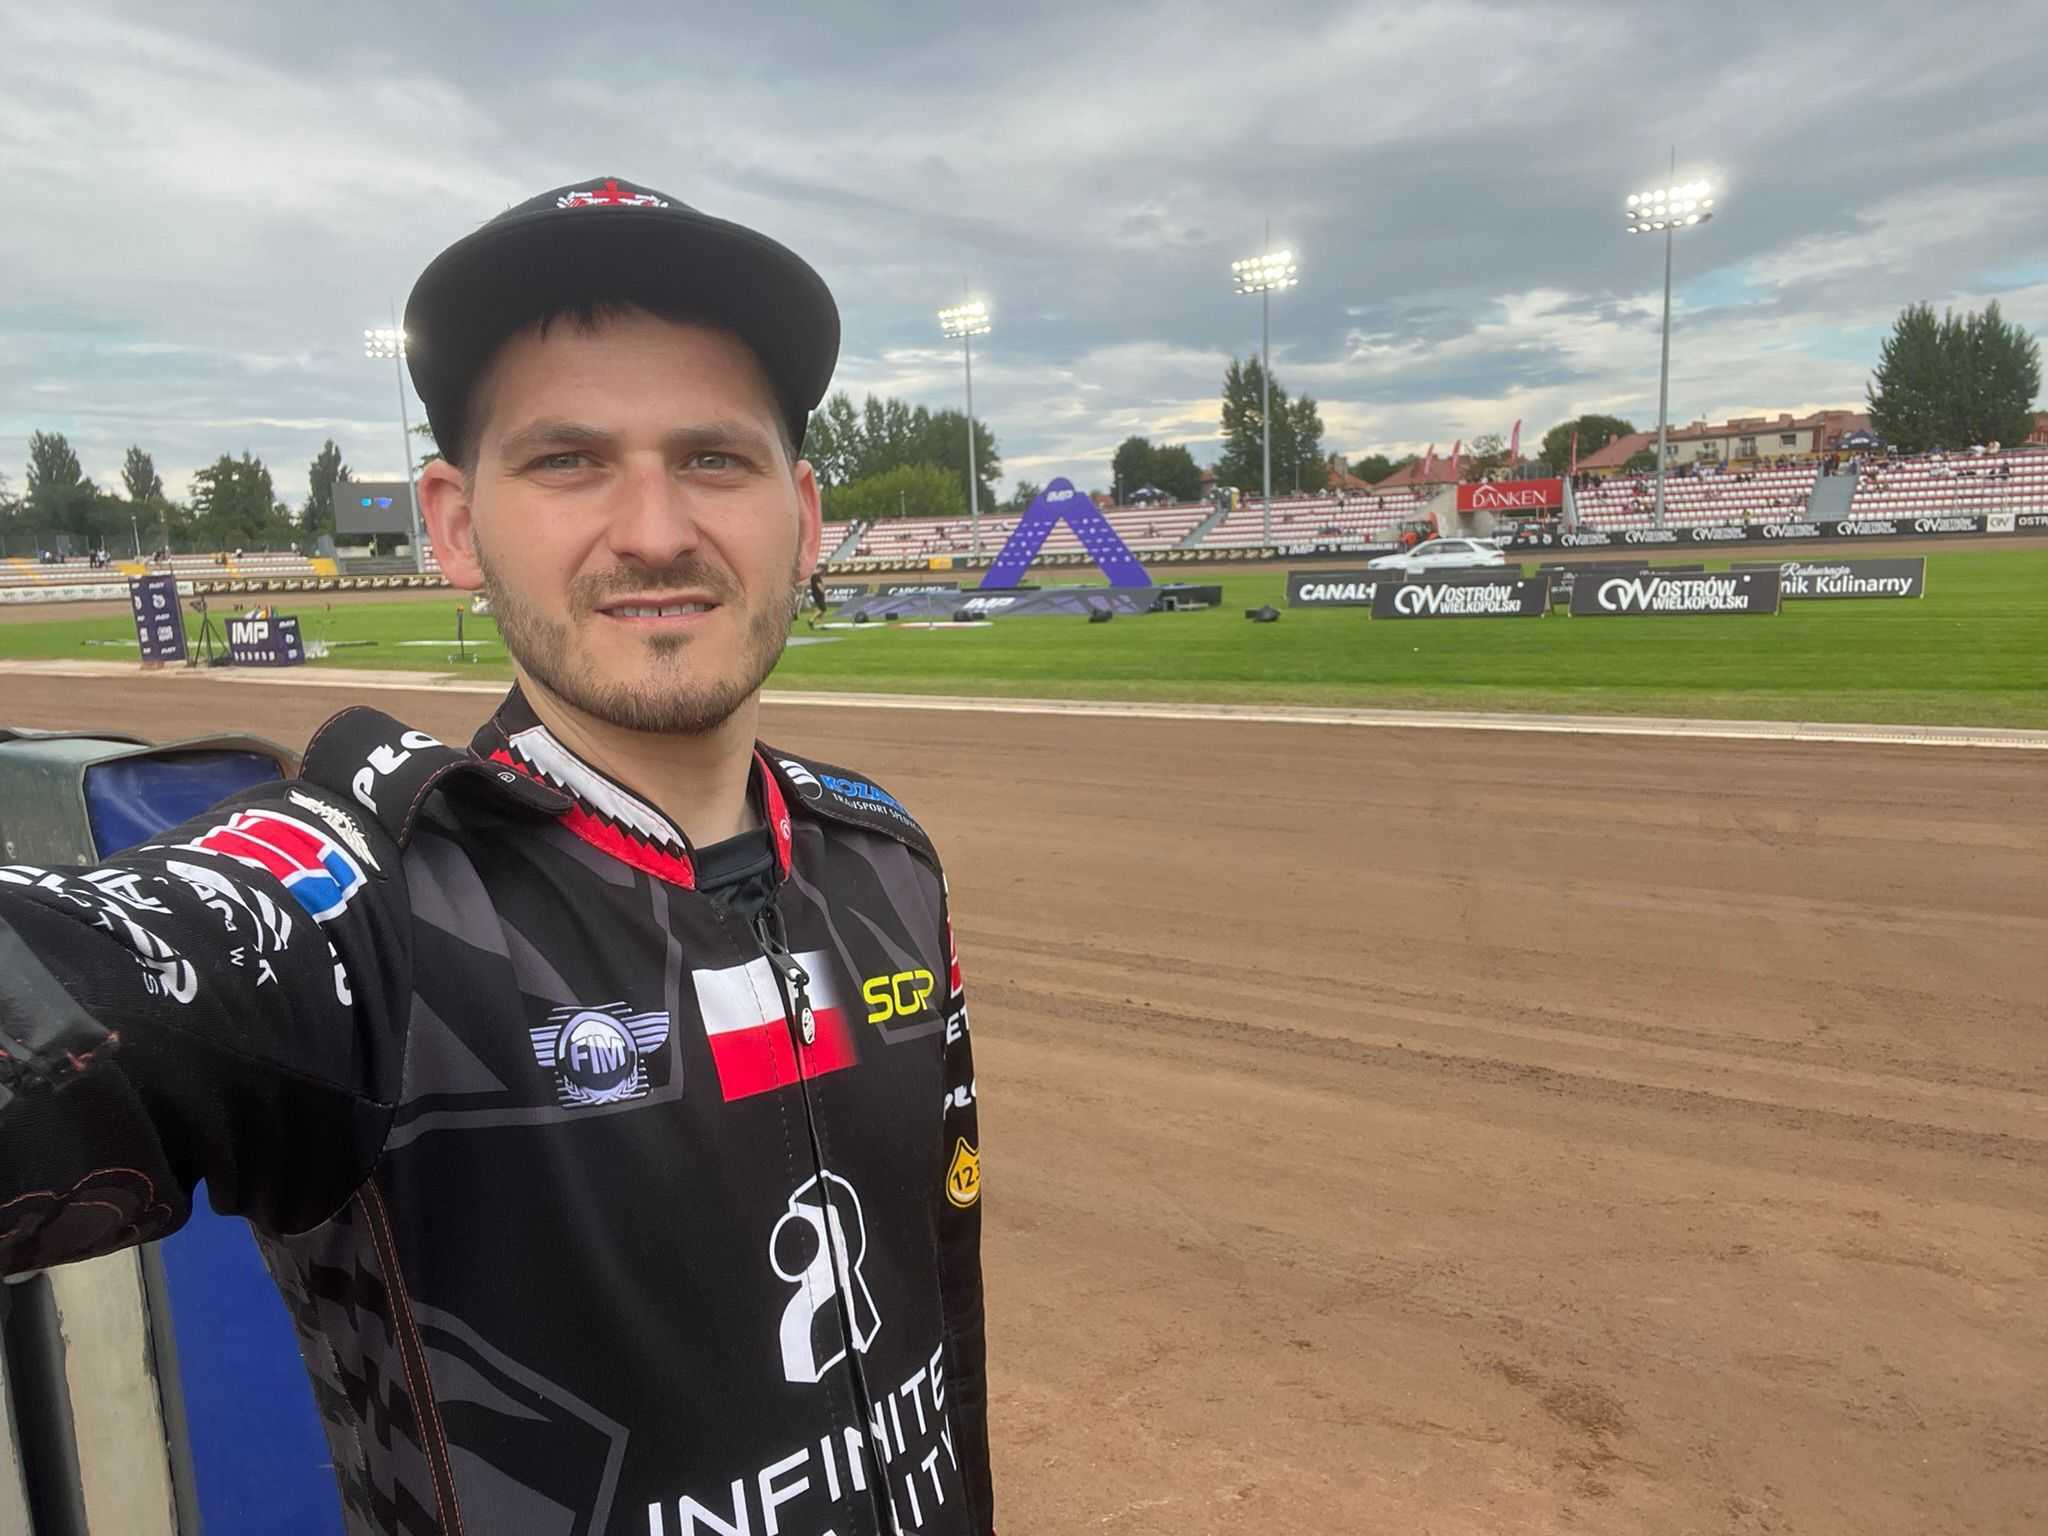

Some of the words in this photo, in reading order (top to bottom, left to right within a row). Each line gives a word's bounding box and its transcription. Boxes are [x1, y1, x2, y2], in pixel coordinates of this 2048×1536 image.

[1472, 489, 1547, 508] DANKEN
[1444, 582, 1513, 602] OSTRÓW
[1657, 576, 1737, 598] OSTRÓW
[1815, 575, 1913, 596] Kulinarny
[1439, 599, 1522, 614] WIELKOPOLSKI
[1652, 595, 1749, 610] WIELKOPOLSKI
[232, 621, 269, 645] IMP
[570, 1034, 626, 1074] FIM
